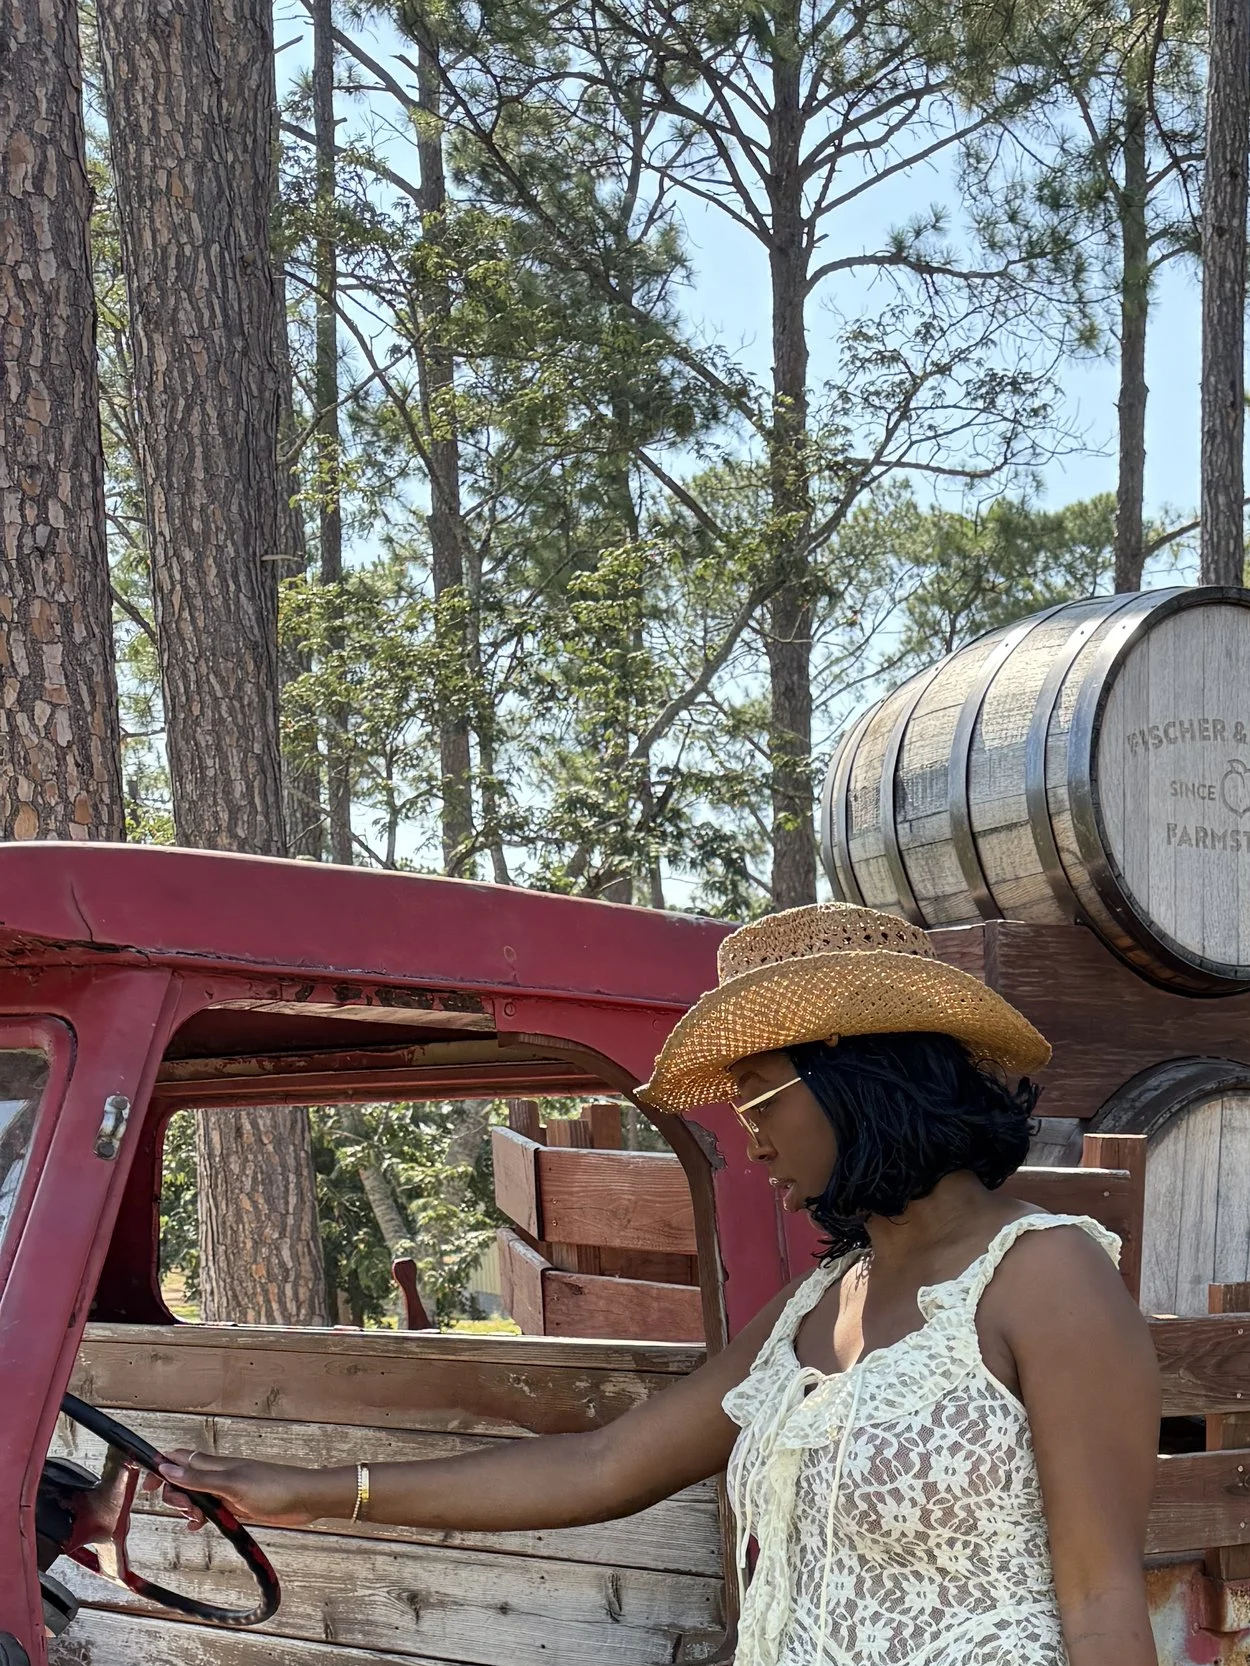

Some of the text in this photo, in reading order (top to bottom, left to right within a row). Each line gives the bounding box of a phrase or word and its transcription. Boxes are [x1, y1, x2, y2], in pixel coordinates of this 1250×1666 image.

[1126, 718, 1226, 757] FISCHER
[1233, 720, 1249, 745] &
[1170, 780, 1217, 801] SINCE
